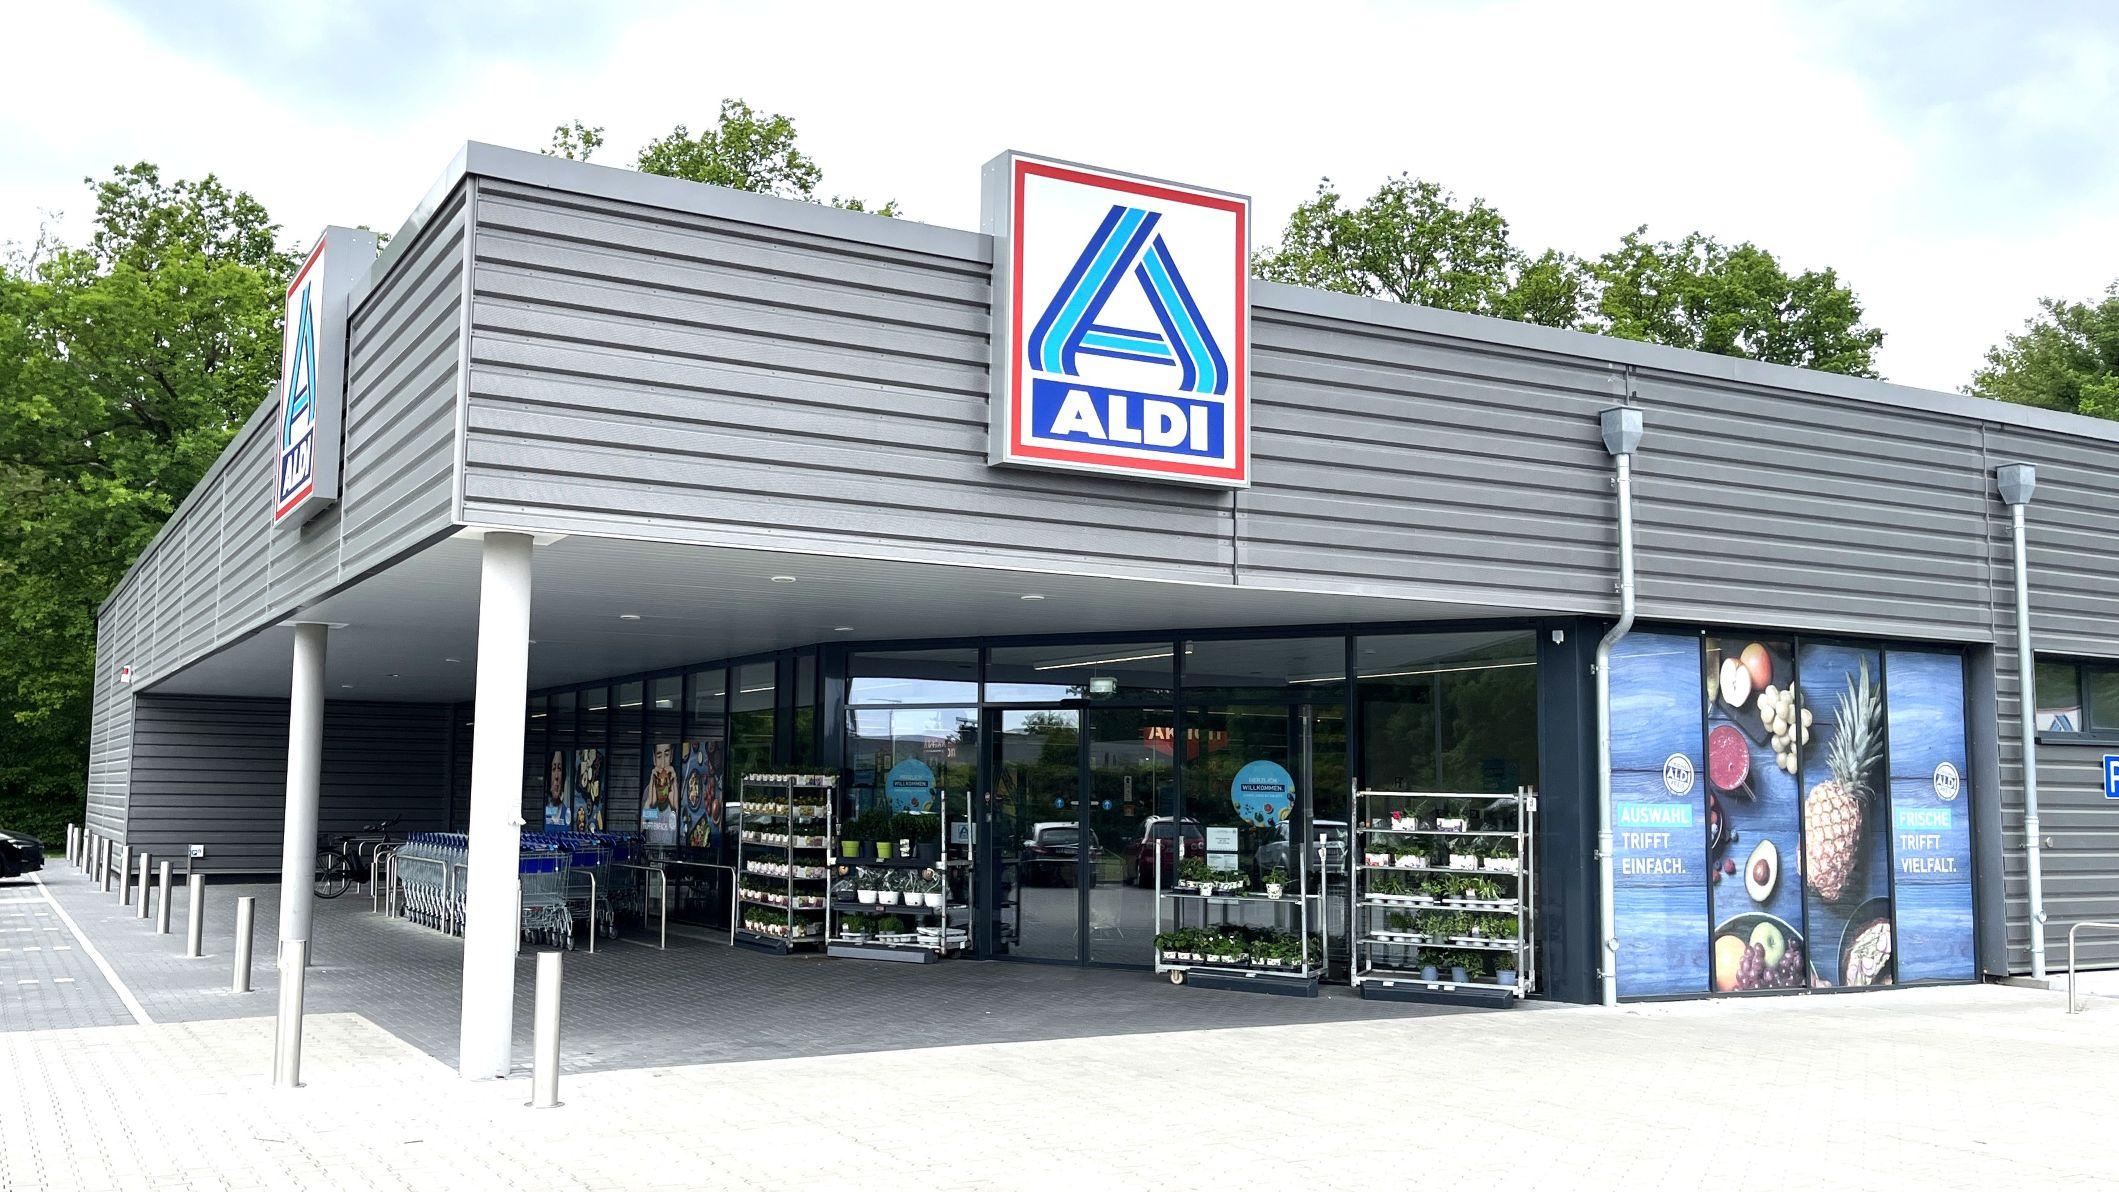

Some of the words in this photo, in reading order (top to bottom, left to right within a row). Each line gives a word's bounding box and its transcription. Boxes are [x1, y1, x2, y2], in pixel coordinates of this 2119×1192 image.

[1049, 388, 1209, 452] ALDI
[282, 433, 312, 497] ALDI
[1667, 766, 1691, 785] ALDI
[1621, 806, 1690, 824] AUSWAHL
[1899, 811, 1950, 827] FRISCHE
[1621, 832, 1670, 849] TRIFFT
[1900, 834, 1941, 850] TRIFFT
[1621, 858, 1687, 875] EINFACH.
[1901, 857, 1957, 873] VIELFALT.
